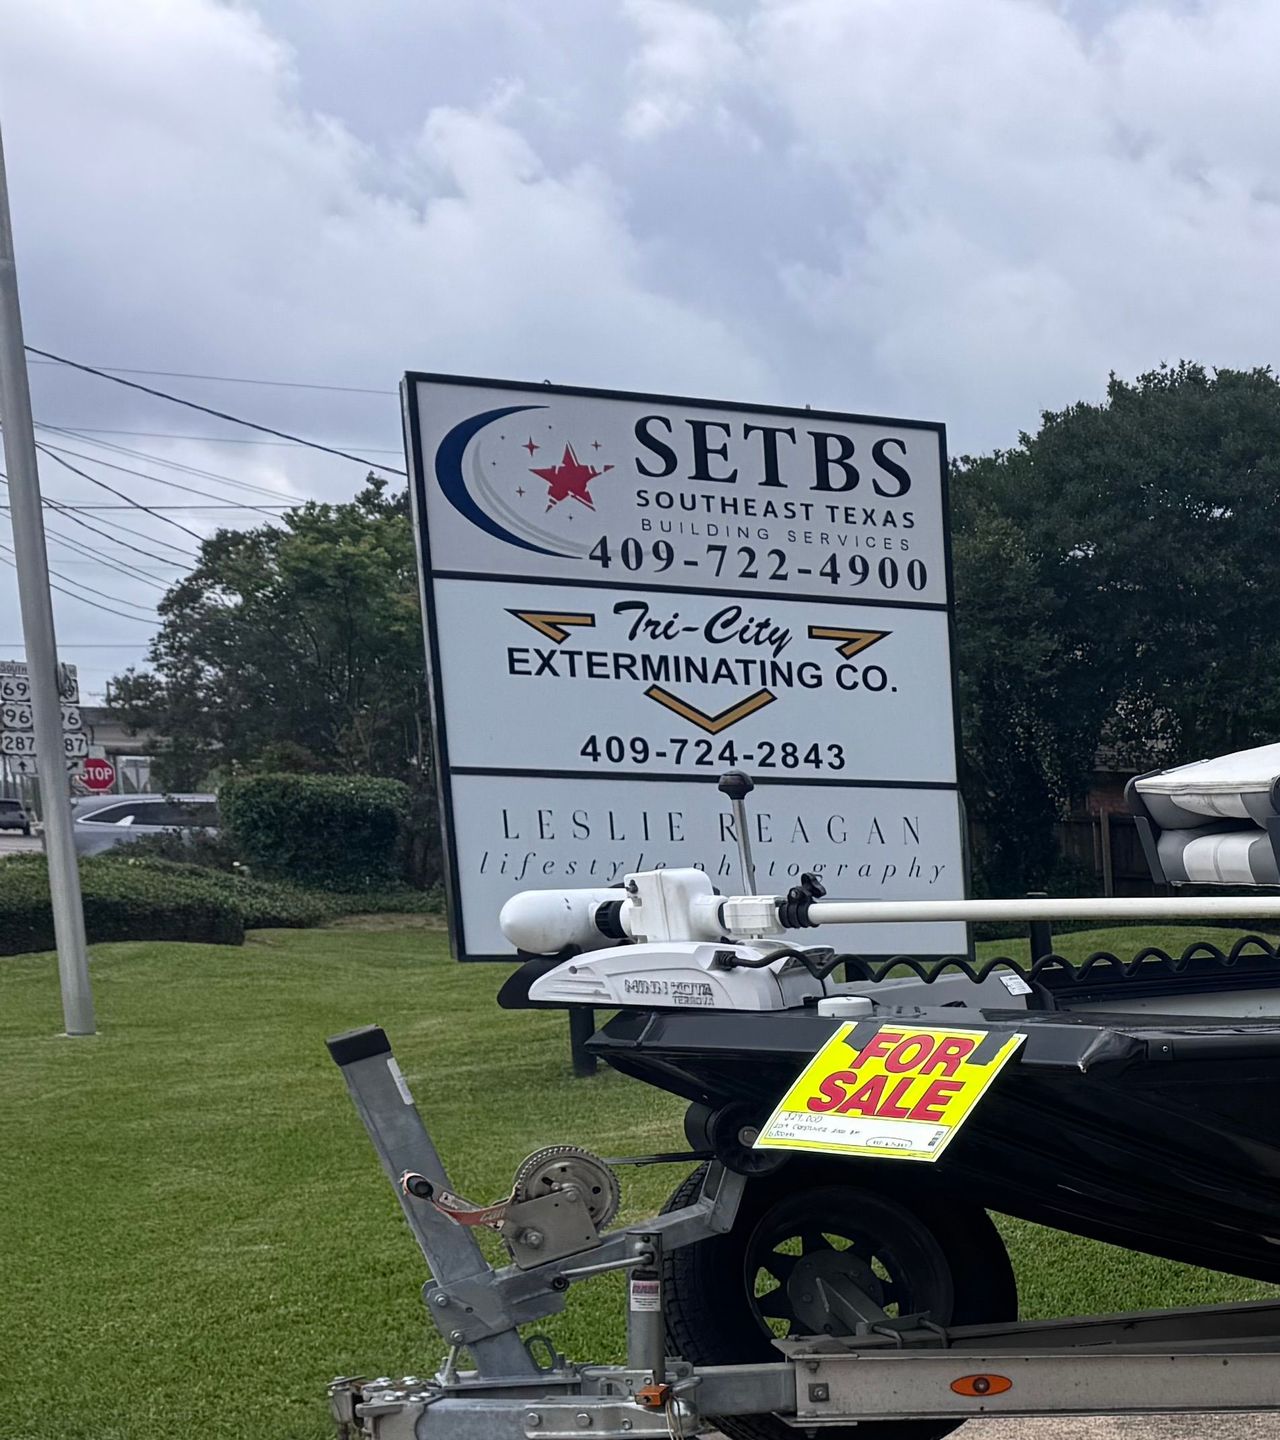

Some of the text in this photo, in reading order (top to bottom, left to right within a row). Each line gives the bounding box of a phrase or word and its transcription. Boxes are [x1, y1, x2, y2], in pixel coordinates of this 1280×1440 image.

[633, 415, 912, 498] SETBS
[635, 489, 916, 529] SOUTHEAST TEXAS
[641, 518, 910, 551] BUILDING SERVICES
[588, 535, 928, 591] 409-722-4900
[613, 600, 794, 659] Tri-City
[506, 646, 899, 693] EXTERMINATING CO.
[3, 682, 27, 696] 69
[5, 708, 30, 725] 96
[3, 735, 35, 751] 287
[580, 734, 847, 771] 409-724-2843
[80, 767, 112, 780] STOP
[502, 809, 920, 845] LESLIE REAGAN
[479, 851, 666, 881] lifestyle
[849, 1032, 975, 1077] FOR
[806, 1070, 966, 1121] SALE
